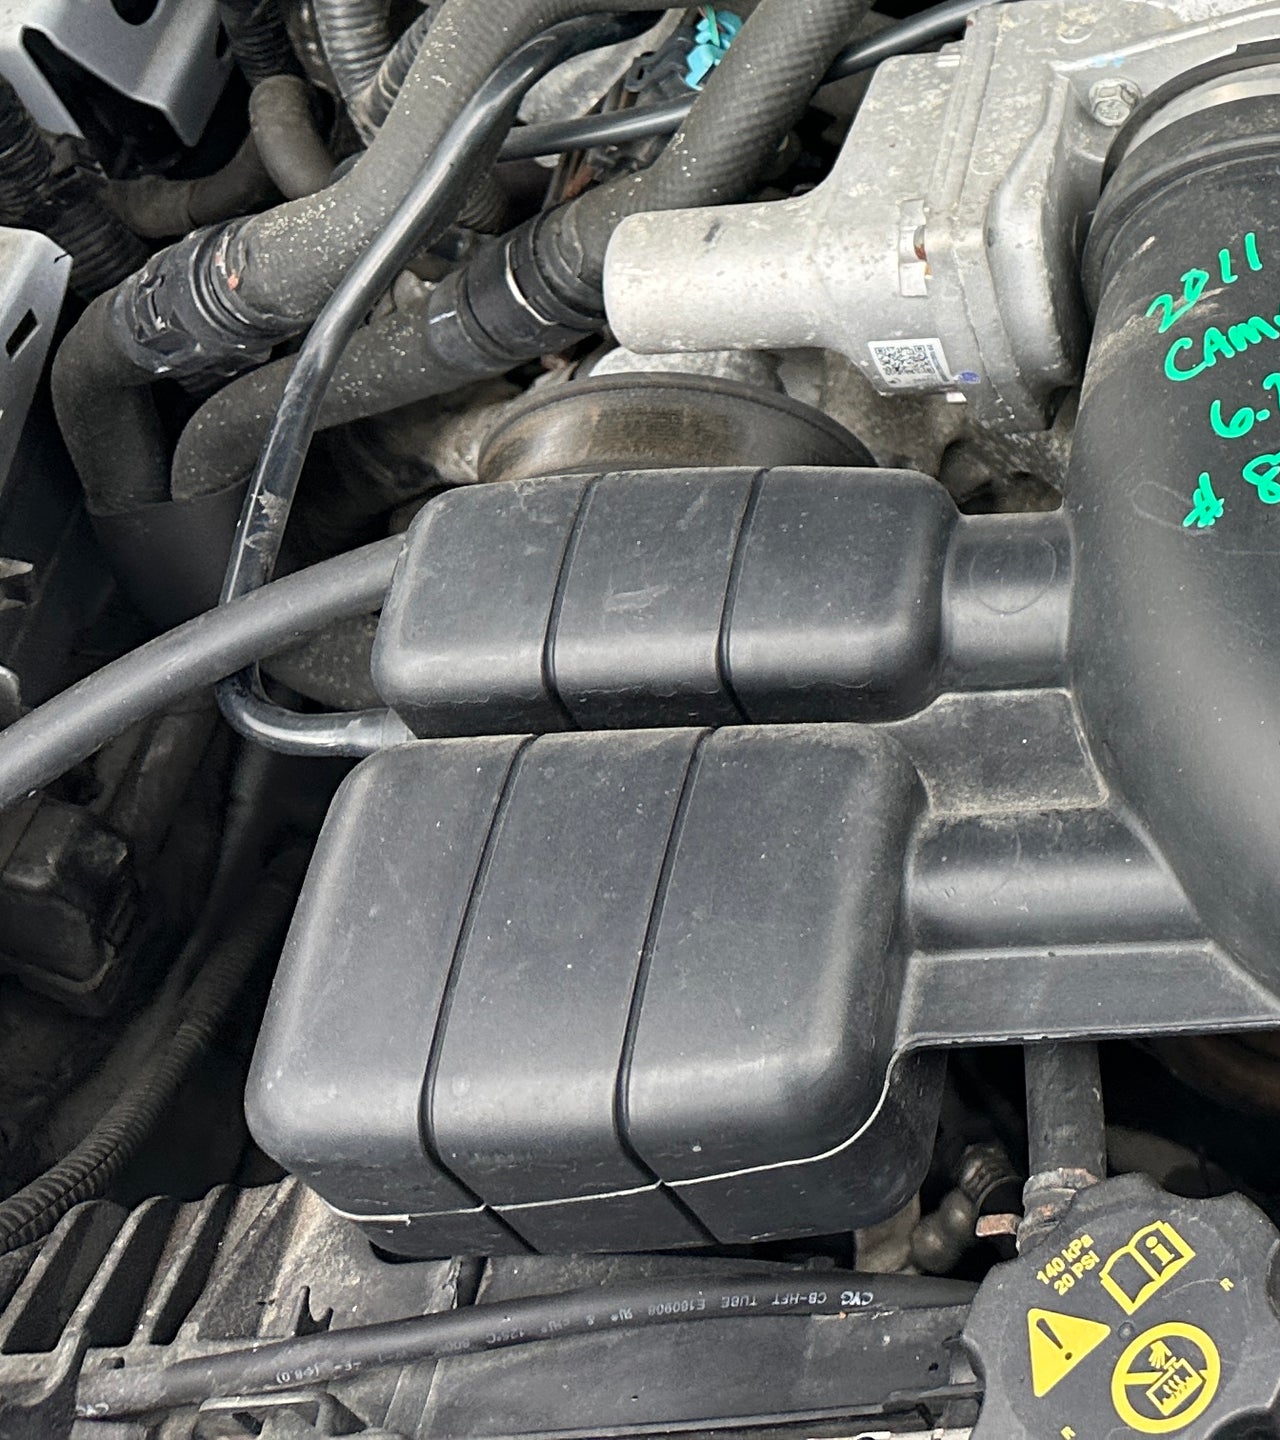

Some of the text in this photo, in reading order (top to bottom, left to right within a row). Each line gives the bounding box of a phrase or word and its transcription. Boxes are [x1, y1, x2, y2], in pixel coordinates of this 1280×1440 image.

[1146, 232, 1263, 333] 2011
[1036, 1234, 1094, 1285] 140 kPa
[1054, 1250, 1100, 1296] 20 PSI
[721, 1295, 758, 1309] TUBE
[771, 1292, 827, 1306] CB-HFT
[840, 1291, 874, 1306] CYG
